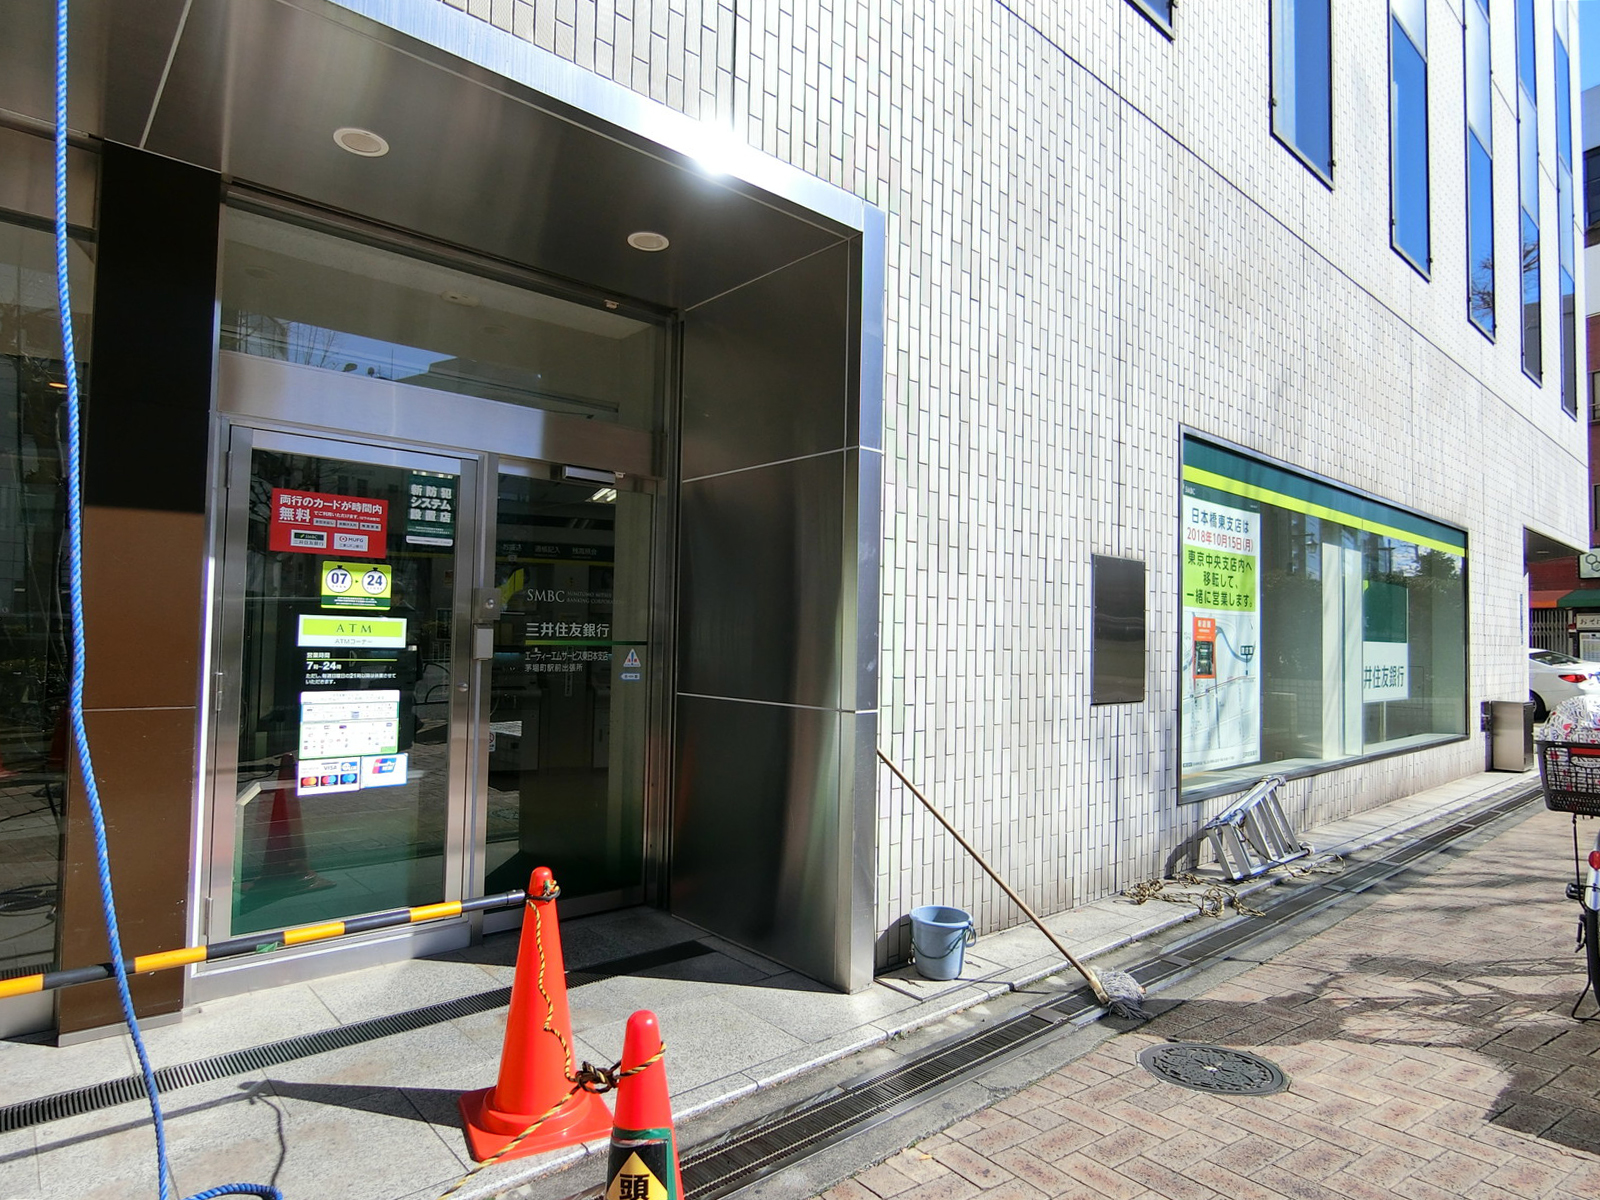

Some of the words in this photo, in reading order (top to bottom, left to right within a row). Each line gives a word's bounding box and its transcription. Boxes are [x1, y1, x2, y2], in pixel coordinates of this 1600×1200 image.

[280, 494, 382, 515] 両行のカードが時間内
[411, 497, 451, 511] システム
[279, 507, 311, 522] 無料
[1192, 507, 1250, 534] 日本橋東支店は
[1187, 527, 1254, 552] 2018年10月15日(月)
[1187, 549, 1253, 573] 東京中央支店内へ
[331, 572, 348, 585] 07
[367, 574, 383, 586] 24
[1203, 570, 1239, 589] 移転して、
[527, 588, 565, 603] SMBC
[1186, 587, 1253, 608] 一緒に営業します。
[336, 623, 372, 633] ATM
[525, 622, 610, 637] 三井住友銀行
[1363, 664, 1405, 689] 井住友銀行
[619, 1173, 650, 1200] 頭
